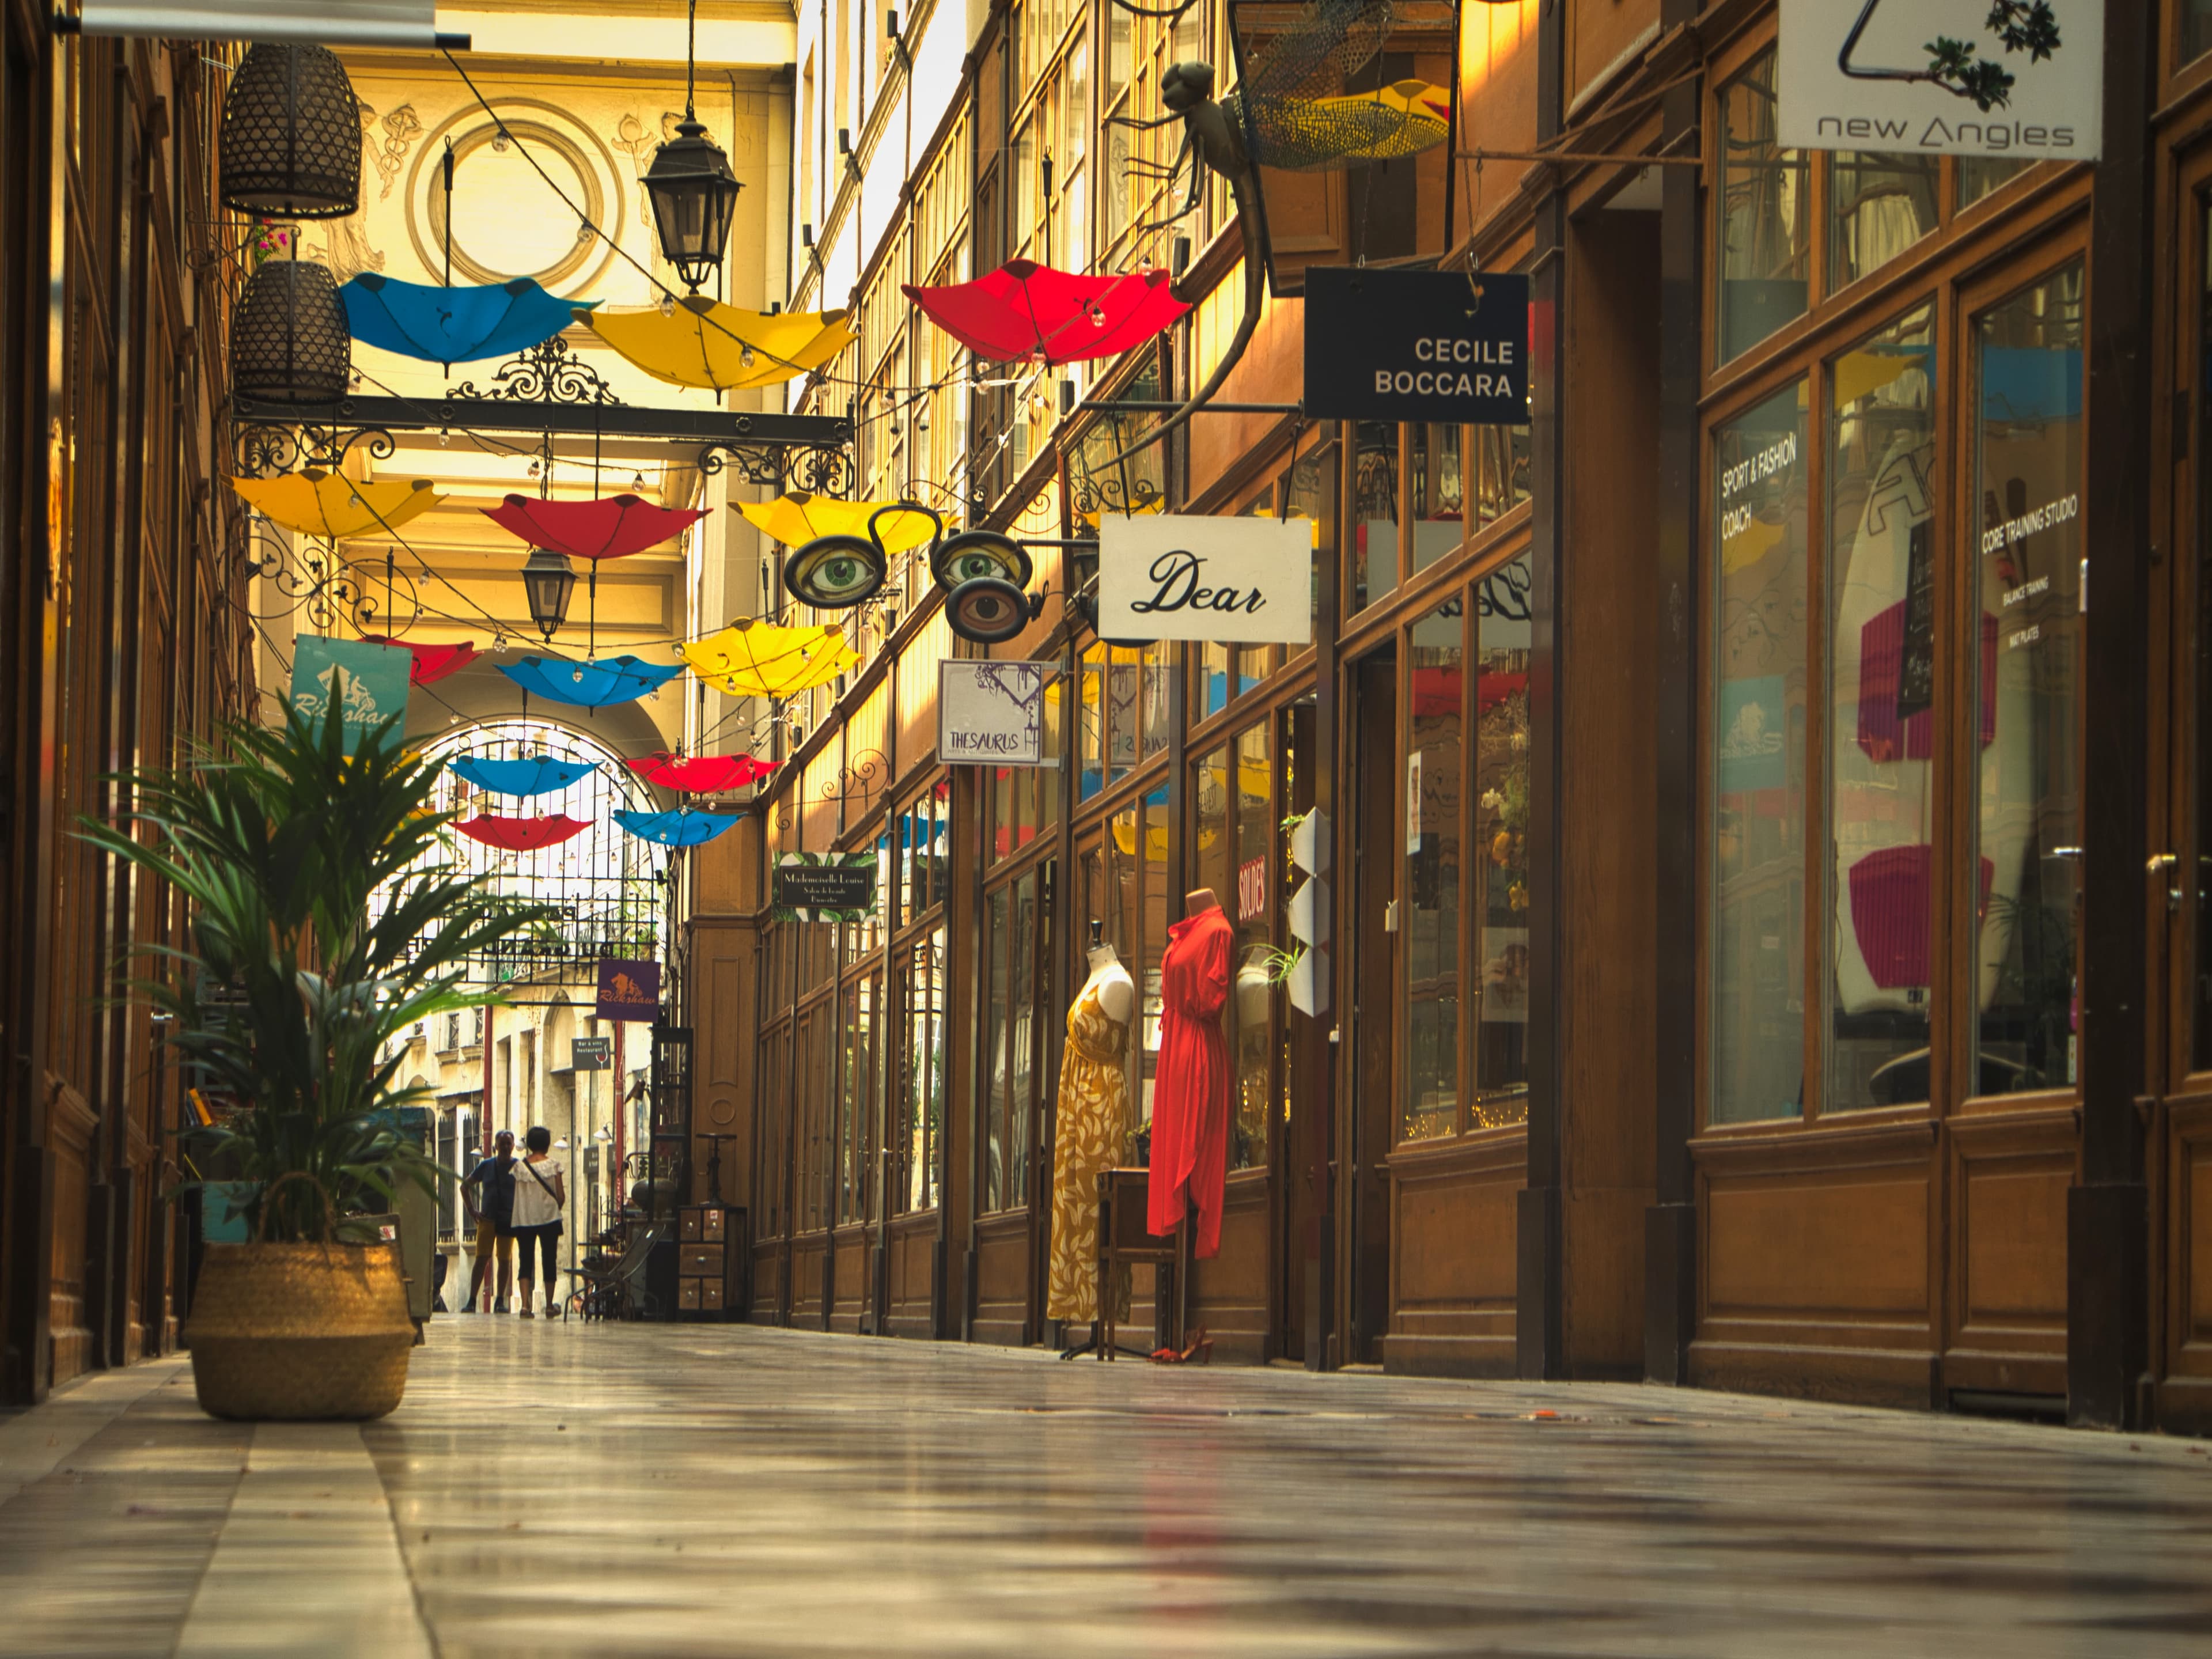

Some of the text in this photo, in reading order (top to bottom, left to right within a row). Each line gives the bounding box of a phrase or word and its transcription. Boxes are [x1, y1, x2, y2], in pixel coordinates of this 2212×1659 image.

[1818, 117, 2074, 149] new Angles
[1415, 338, 1513, 364] CECILE
[1376, 370, 1513, 397] BOCCARA
[1723, 431, 1796, 498] SPORT & FASHION
[1723, 502, 1751, 540] COACH
[1983, 494, 2077, 555] CORE TRAINING STUDIO
[1131, 550, 1266, 613] Dear
[2003, 575, 2048, 607] BALANCE TRAINING
[2010, 627, 2019, 648] MAT
[950, 732, 1018, 754] THESAURUS
[785, 873, 864, 884] Mademoiselle Louise
[1240, 861, 1264, 921] SOLDES
[599, 990, 656, 1004] Rickshaw
